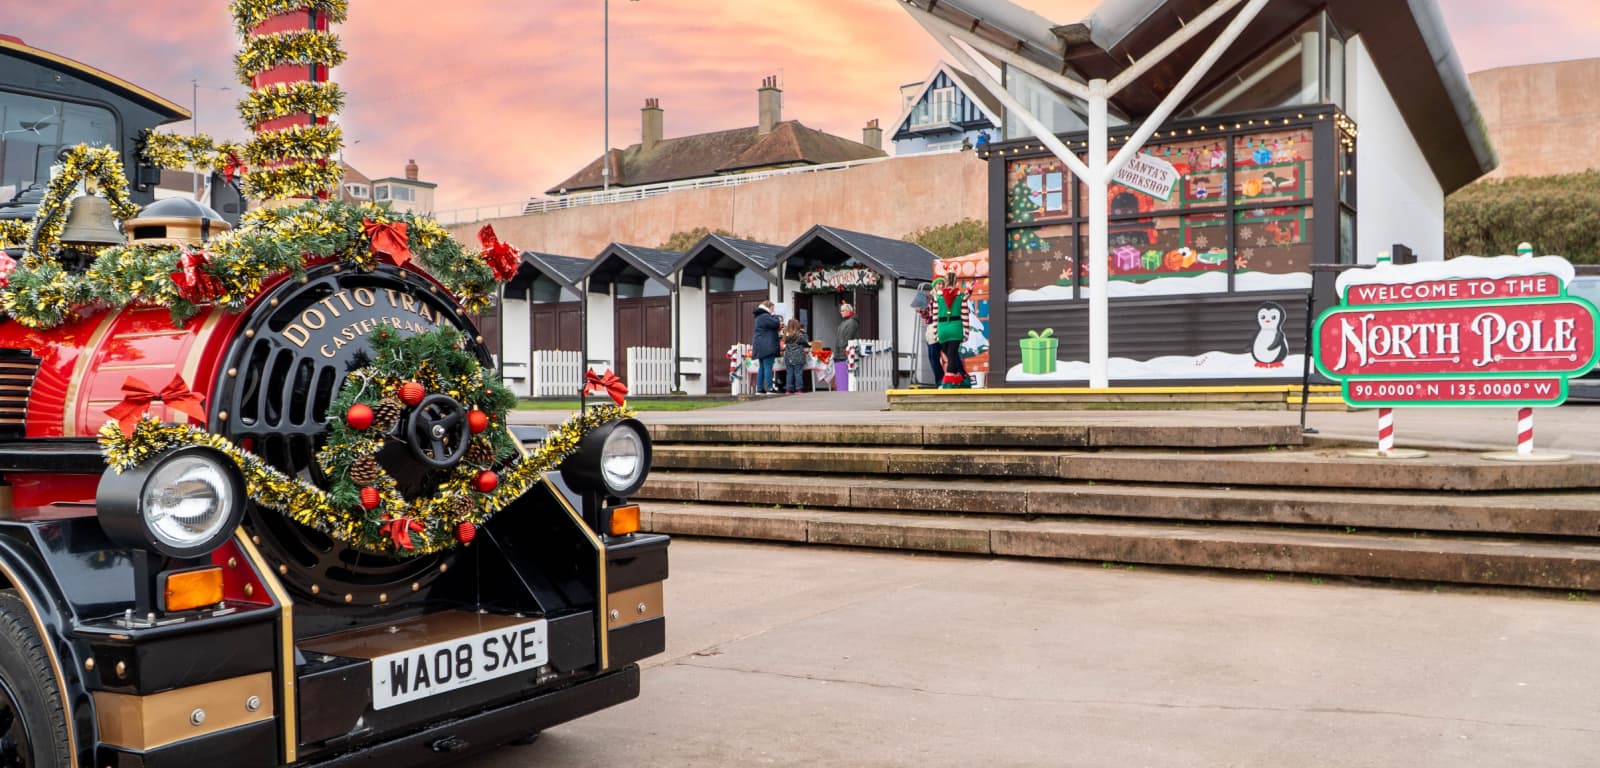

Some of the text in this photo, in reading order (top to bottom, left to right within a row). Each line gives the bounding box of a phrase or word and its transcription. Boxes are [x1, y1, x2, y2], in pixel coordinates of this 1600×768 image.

[1117, 168, 1170, 195] WORKSHOP
[1128, 159, 1168, 181] SANTA'S
[1359, 278, 1547, 300] WELCOME TO THE
[282, 288, 376, 348] DOTTO
[1334, 312, 1577, 371] NORTH POLE
[1355, 383, 1552, 396] 90.0000° N 135.0000° W
[390, 627, 537, 697] WA08 SXE
